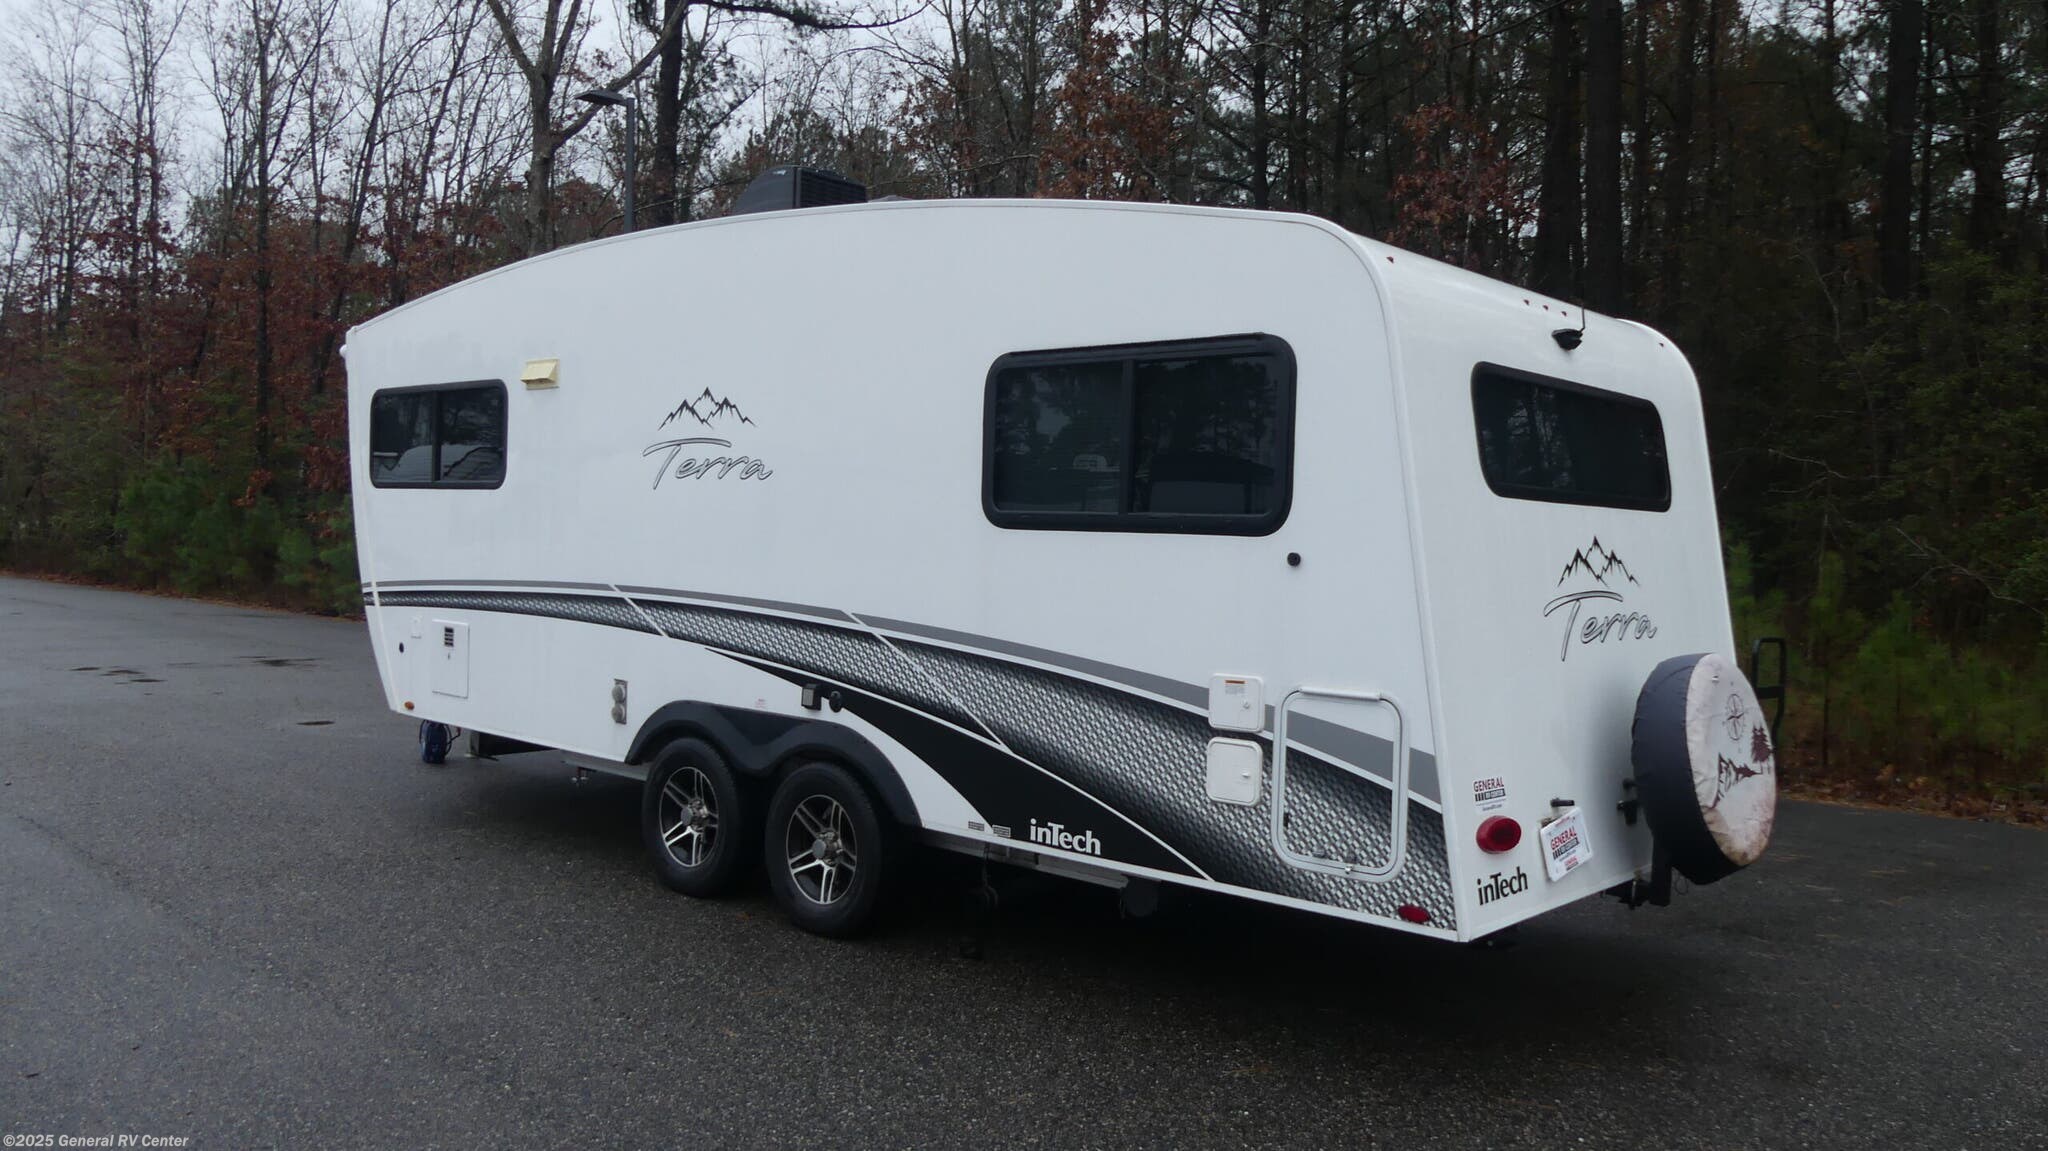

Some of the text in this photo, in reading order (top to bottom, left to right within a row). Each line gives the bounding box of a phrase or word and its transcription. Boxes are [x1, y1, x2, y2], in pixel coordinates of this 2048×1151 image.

[642, 437, 774, 490] Terra
[1543, 590, 1658, 662] Terra
[1473, 776, 1505, 793] GENERAL
[1030, 818, 1101, 855] inTech
[1550, 826, 1577, 850] GENERAL
[1477, 866, 1529, 905] inTech
